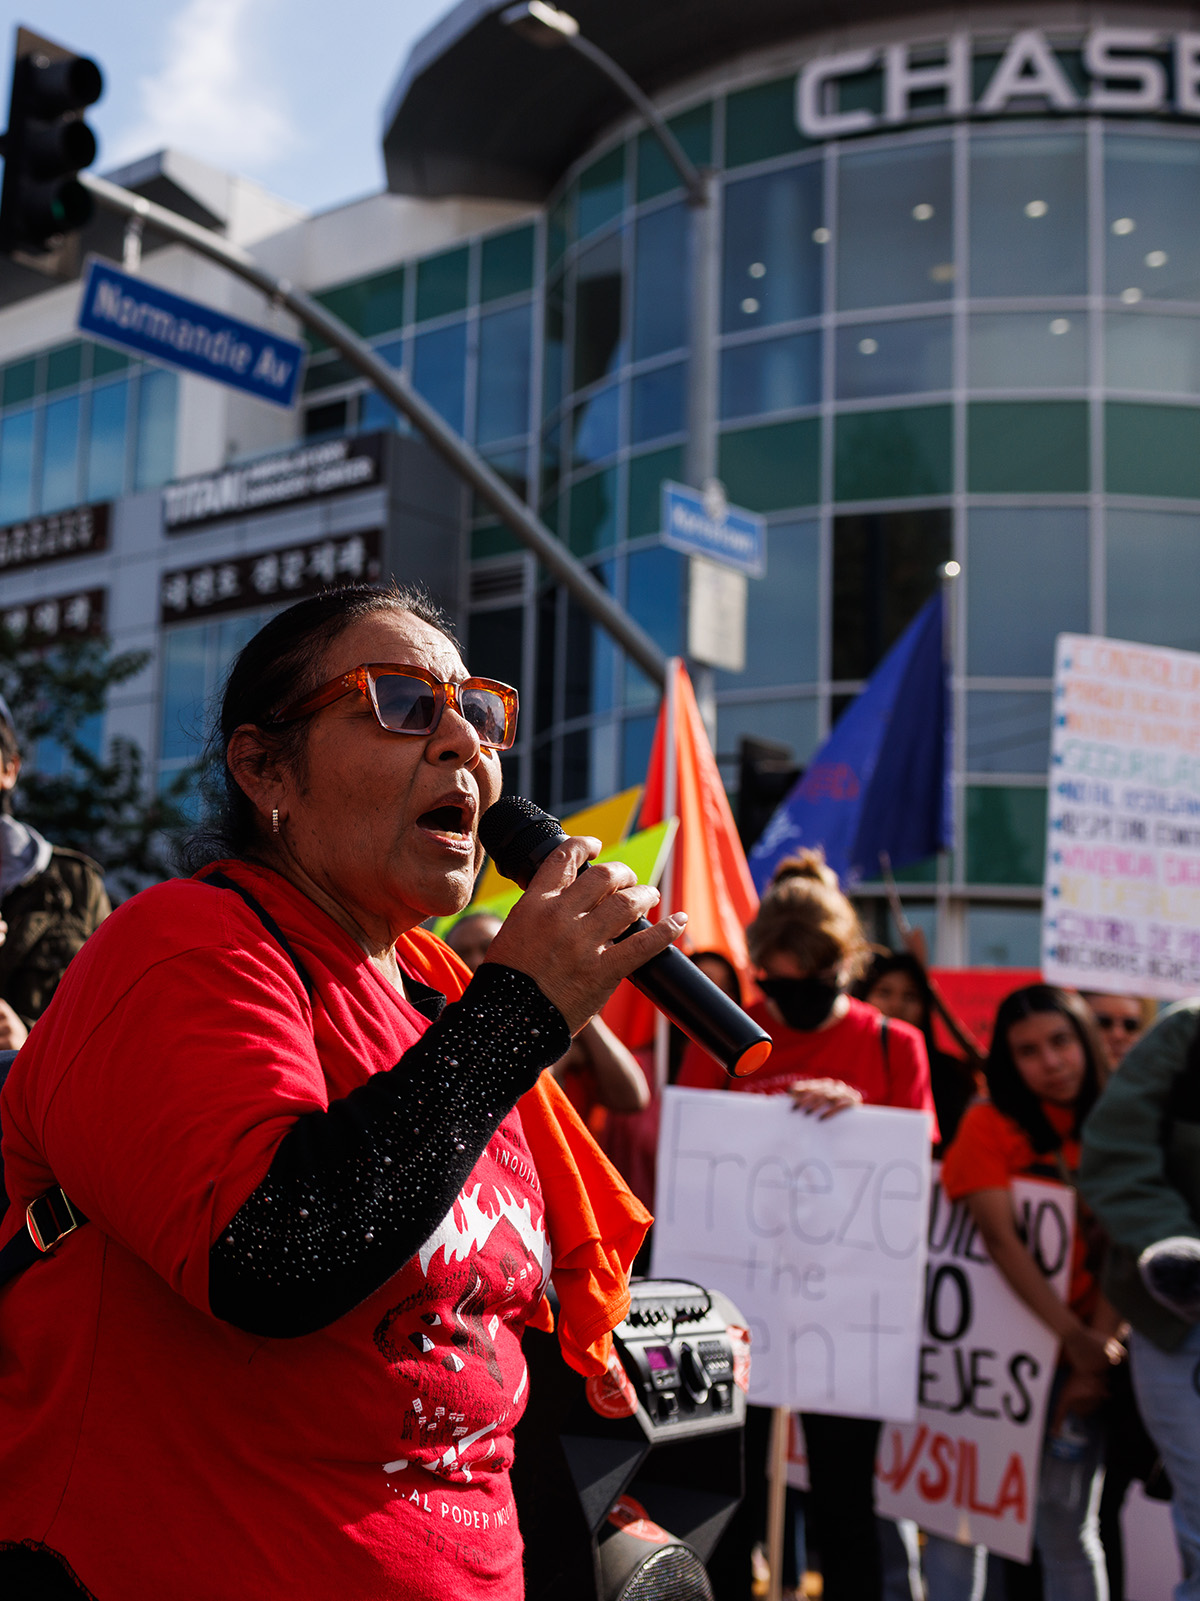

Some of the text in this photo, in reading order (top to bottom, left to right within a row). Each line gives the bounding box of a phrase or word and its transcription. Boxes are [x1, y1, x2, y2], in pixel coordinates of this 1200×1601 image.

[91, 278, 293, 388] Normandie Av
[666, 1100, 924, 1260] Freeze
[738, 1243, 827, 1302] the
[441, 1501, 490, 1530] PODER
